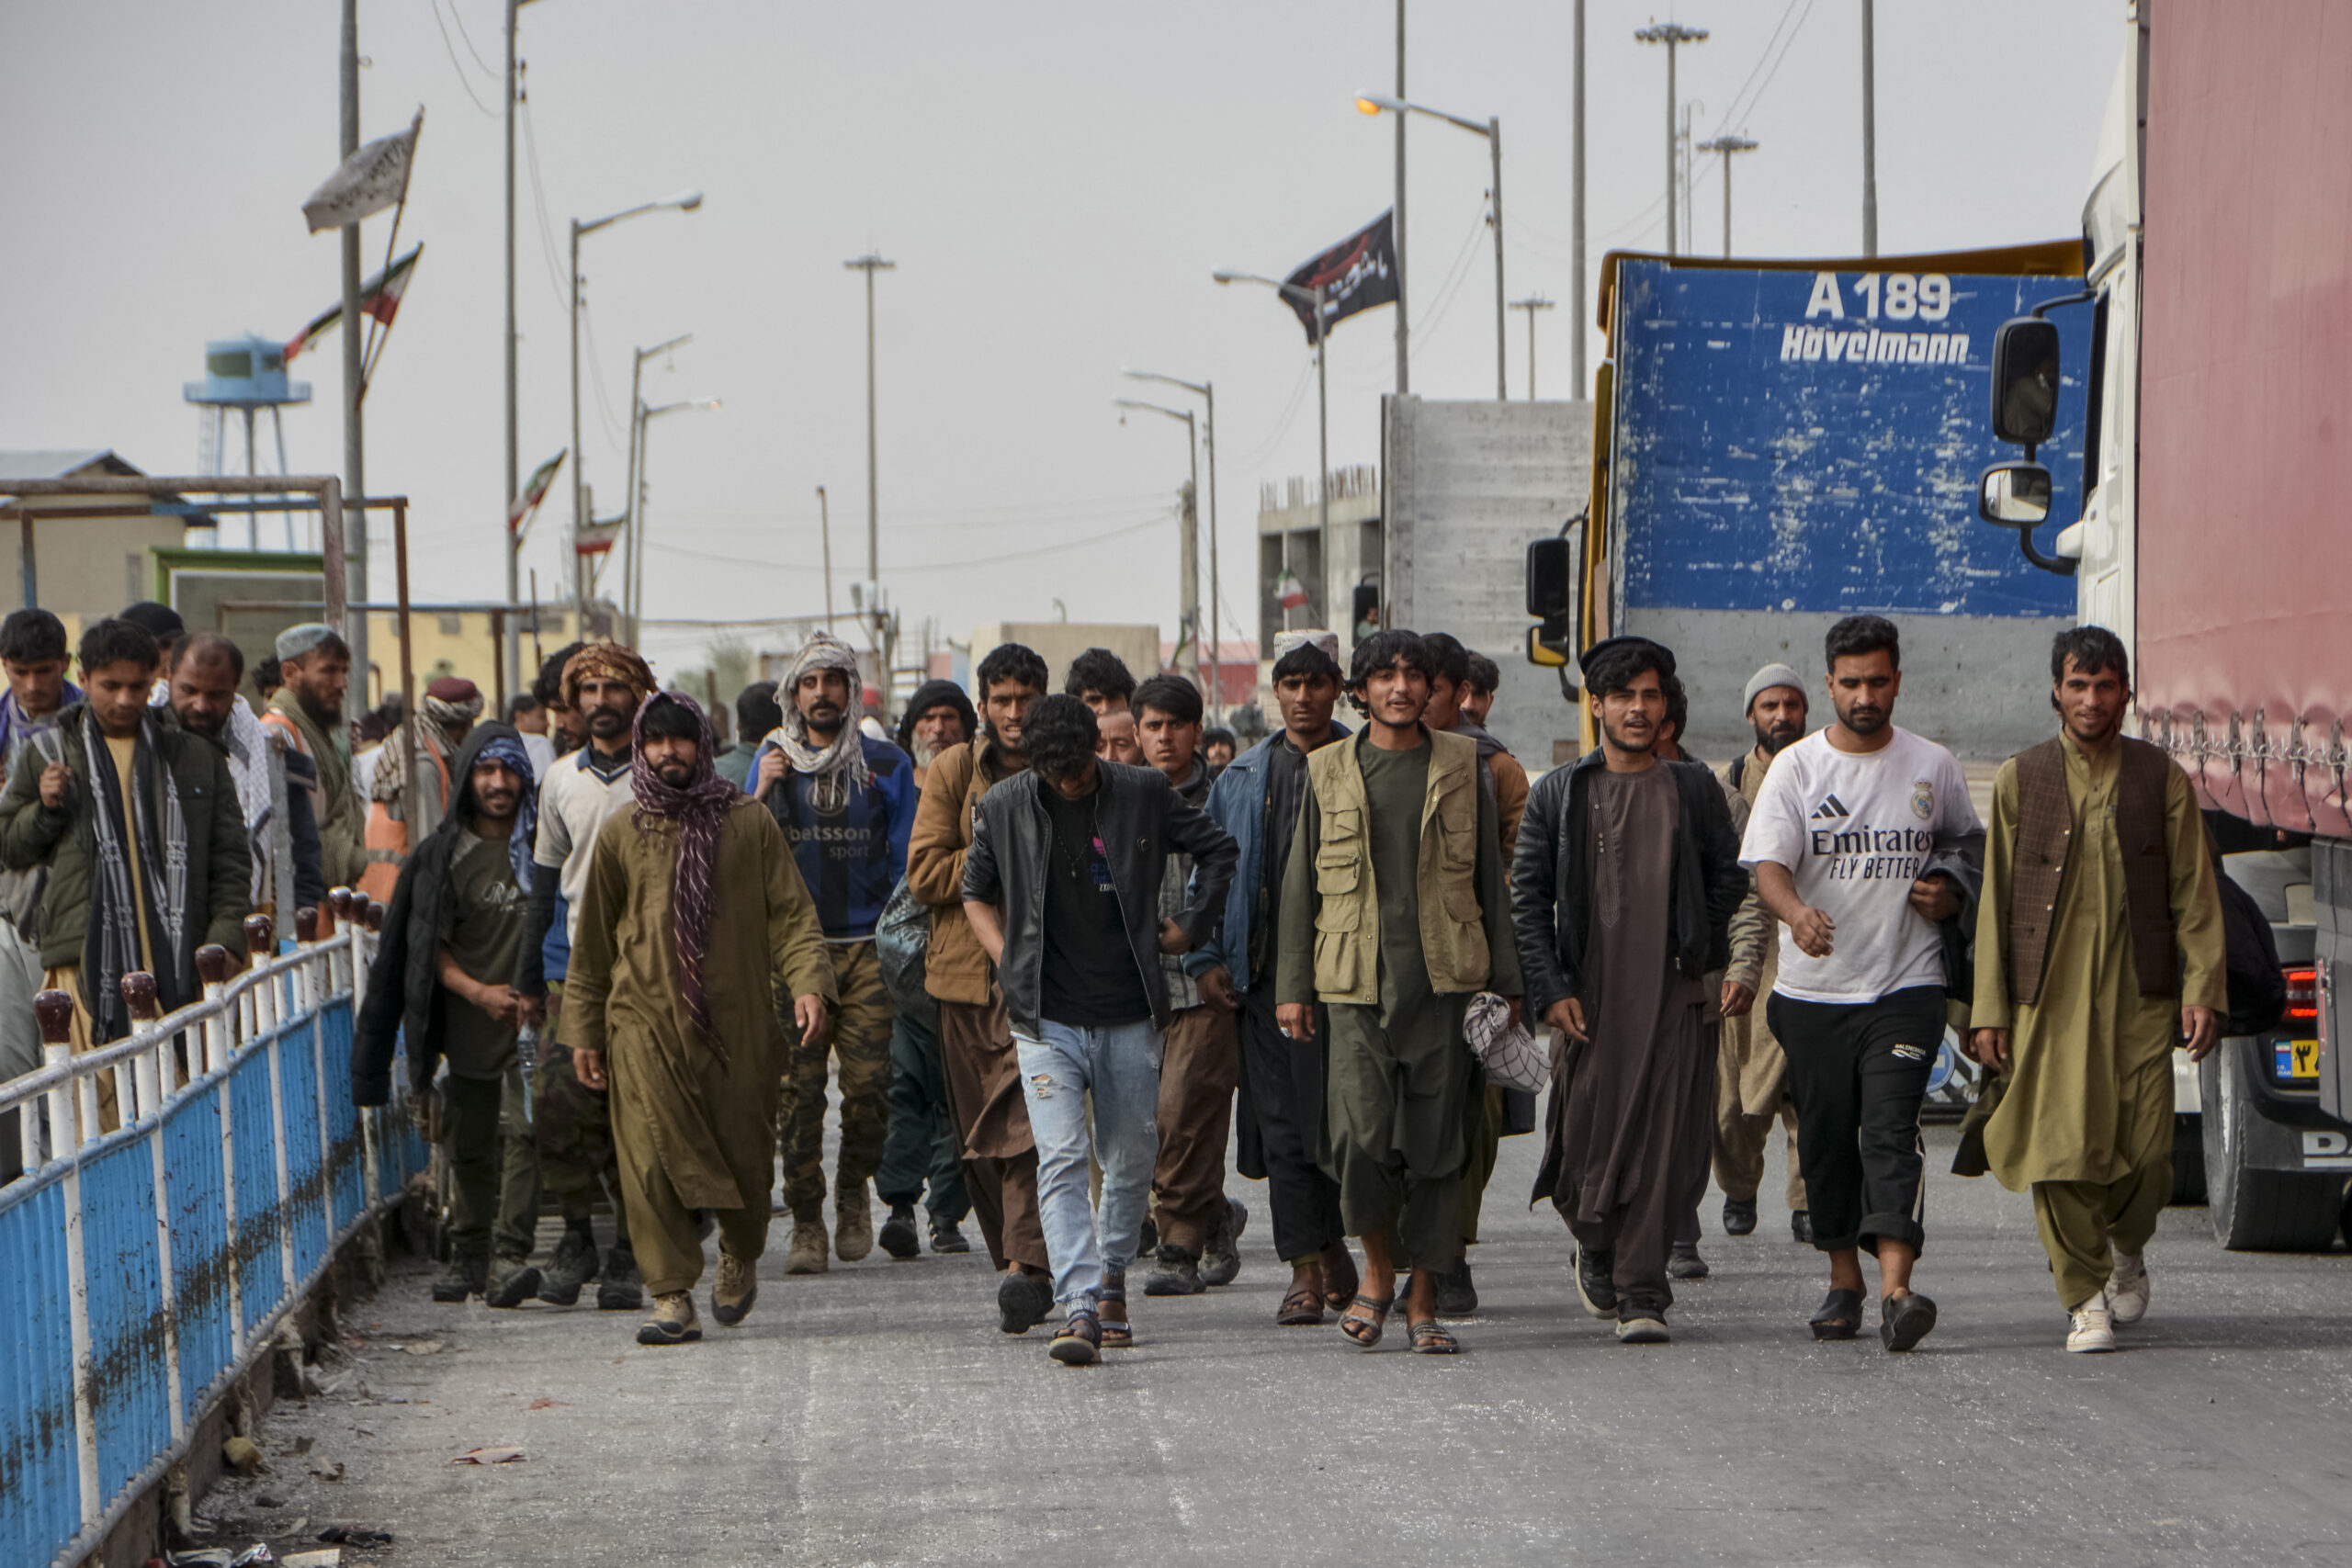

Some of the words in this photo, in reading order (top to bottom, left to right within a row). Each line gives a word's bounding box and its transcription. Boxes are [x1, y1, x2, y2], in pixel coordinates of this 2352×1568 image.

[1804, 271, 1845, 320] A
[1853, 272, 1951, 321] 189
[1780, 323, 1970, 365] Hövelmann
[789, 825, 872, 841] betsson
[1811, 825, 1933, 855] Emirates
[830, 844, 869, 861] sport
[1829, 857, 1859, 880] FLY
[1863, 856, 1919, 880] BETTER
[2302, 1131, 2352, 1156] D
